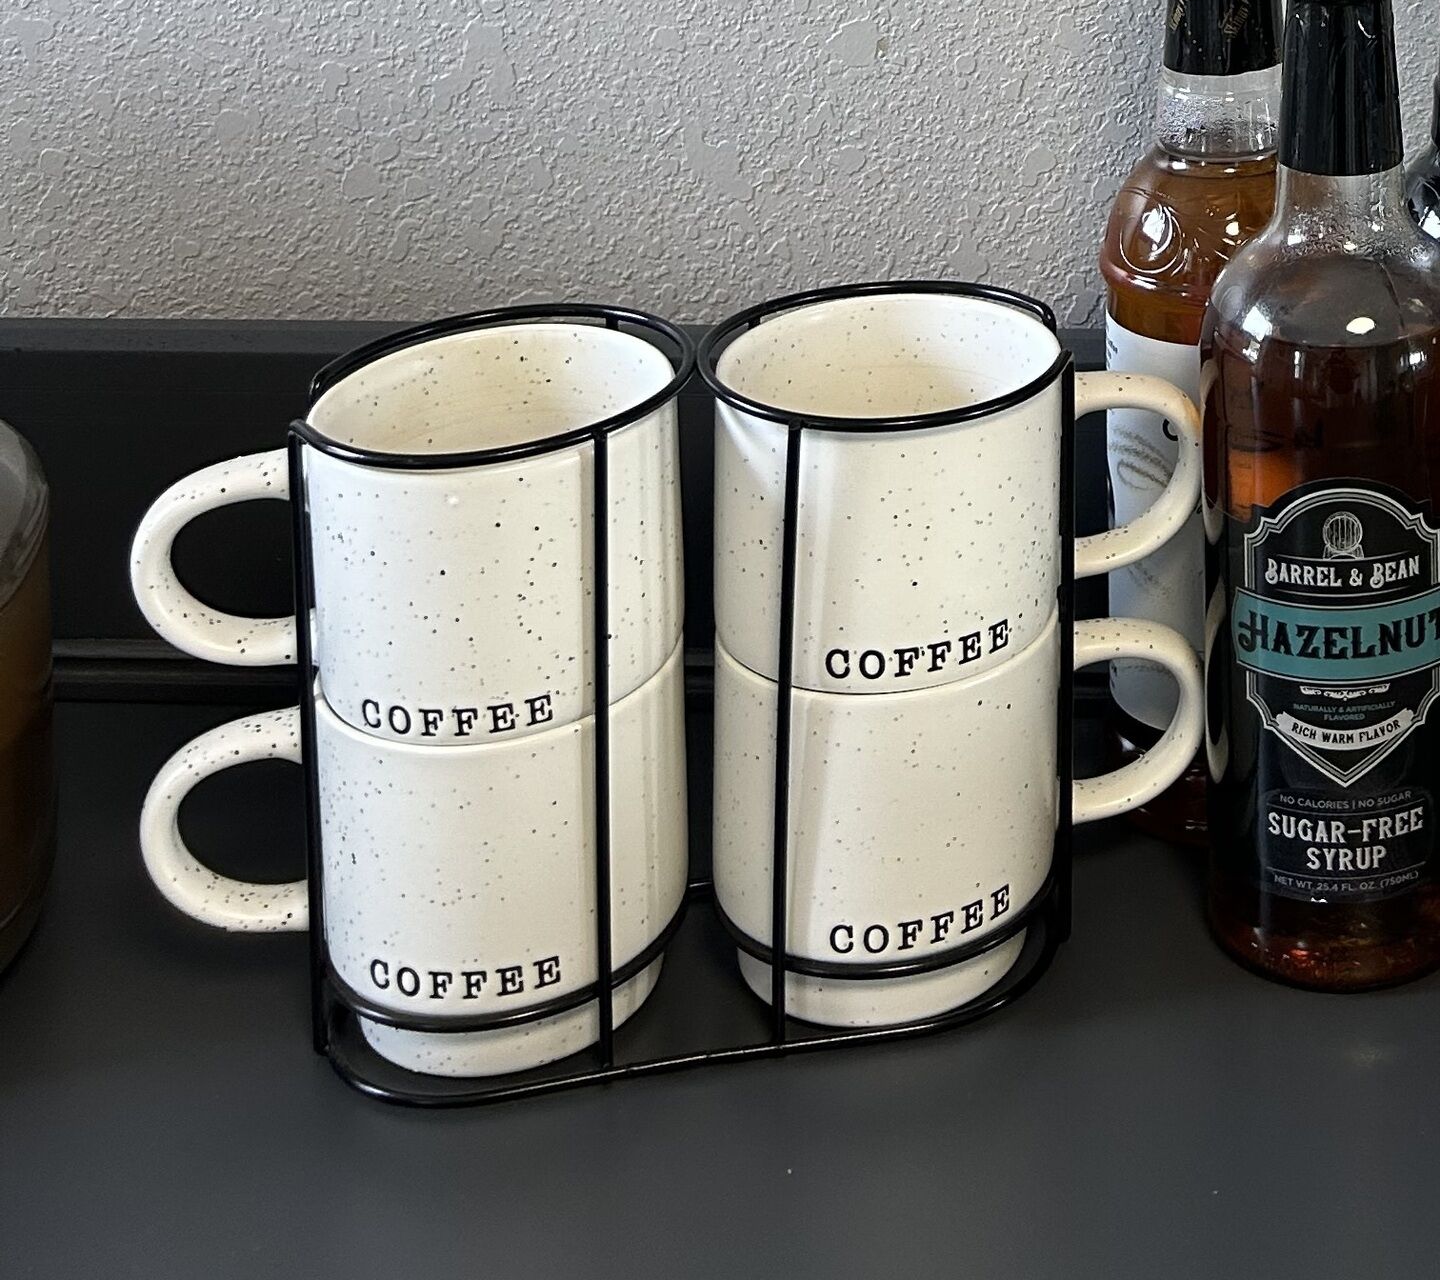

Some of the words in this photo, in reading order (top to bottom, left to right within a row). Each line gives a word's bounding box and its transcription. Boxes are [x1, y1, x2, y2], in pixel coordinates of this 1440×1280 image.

[1265, 557, 1342, 588] BARREL
[1349, 568, 1363, 586] &
[1369, 555, 1420, 589] BEAN
[825, 619, 1012, 680] COFFEE
[361, 695, 554, 736] COFFEE
[1291, 722, 1316, 739] RICH
[1322, 732, 1354, 744] WARM
[1359, 720, 1401, 742] FLAVOR
[1279, 793, 1295, 805] NO
[1297, 799, 1349, 809] CALORIES
[1358, 799, 1374, 808] NO
[1377, 790, 1412, 805] SUGAR
[1268, 806, 1423, 843] SUGAR-FREE
[1306, 845, 1386, 871] SYRUP
[1274, 874, 1293, 886] NET
[829, 884, 1012, 954] COFFEE
[371, 956, 561, 999] COFFEE
